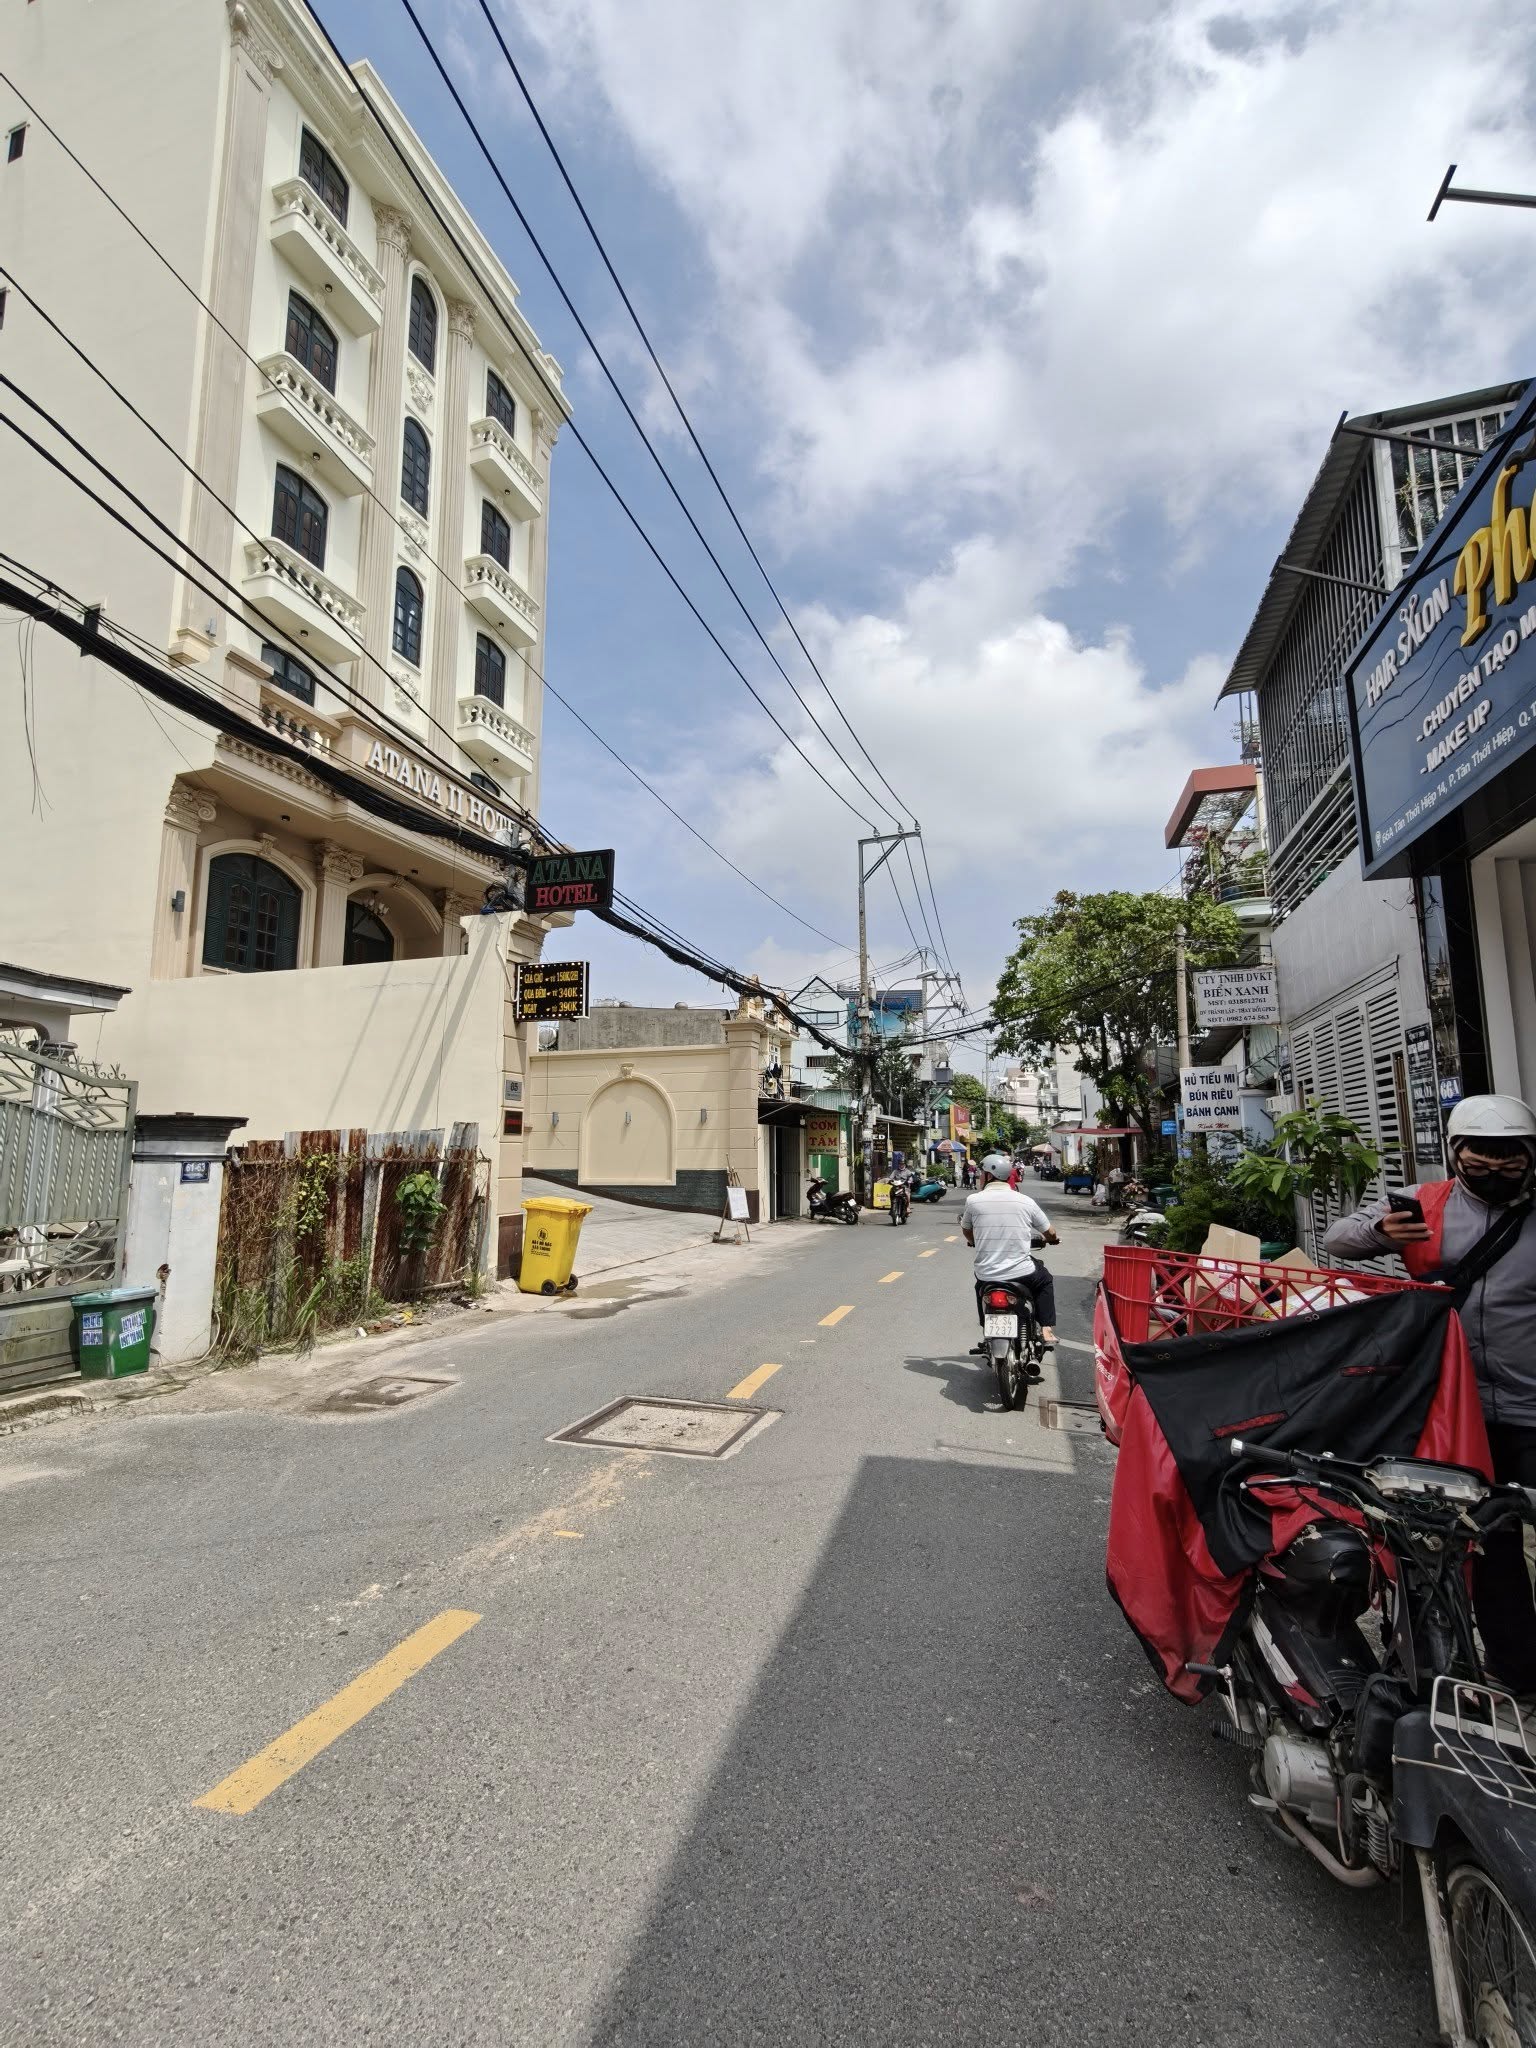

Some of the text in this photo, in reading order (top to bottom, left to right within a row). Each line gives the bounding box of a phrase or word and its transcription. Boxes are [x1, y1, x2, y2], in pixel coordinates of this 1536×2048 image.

[1453, 464, 1536, 647] Ph
[1481, 629, 1518, 676] TẠO
[1366, 649, 1399, 707] HAIR
[1467, 700, 1491, 734] UP
[366, 740, 443, 806] ATANA
[446, 783, 463, 817] II
[1381, 828, 1394, 844] 66A
[1471, 742, 1492, 768] Thới
[531, 856, 606, 885] ATANA
[535, 884, 598, 908] HOTEL
[1197, 971, 1273, 984] CTY TNHH DVKT
[559, 987, 578, 998] 340K
[1203, 984, 1269, 998] BIỂN XANH
[559, 1001, 578, 1012] 390K
[1184, 1072, 1197, 1086] HỦ
[1199, 1071, 1221, 1085] TIẾU
[1189, 1087, 1233, 1101] BÚN RIÊU
[1440, 1080, 1459, 1099] 66A
[1186, 1105, 1240, 1117] BÁNH CANH
[810, 1120, 837, 1130] CƠM
[809, 1132, 837, 1146] TẤM
[989, 1326, 1012, 1336] 7237
